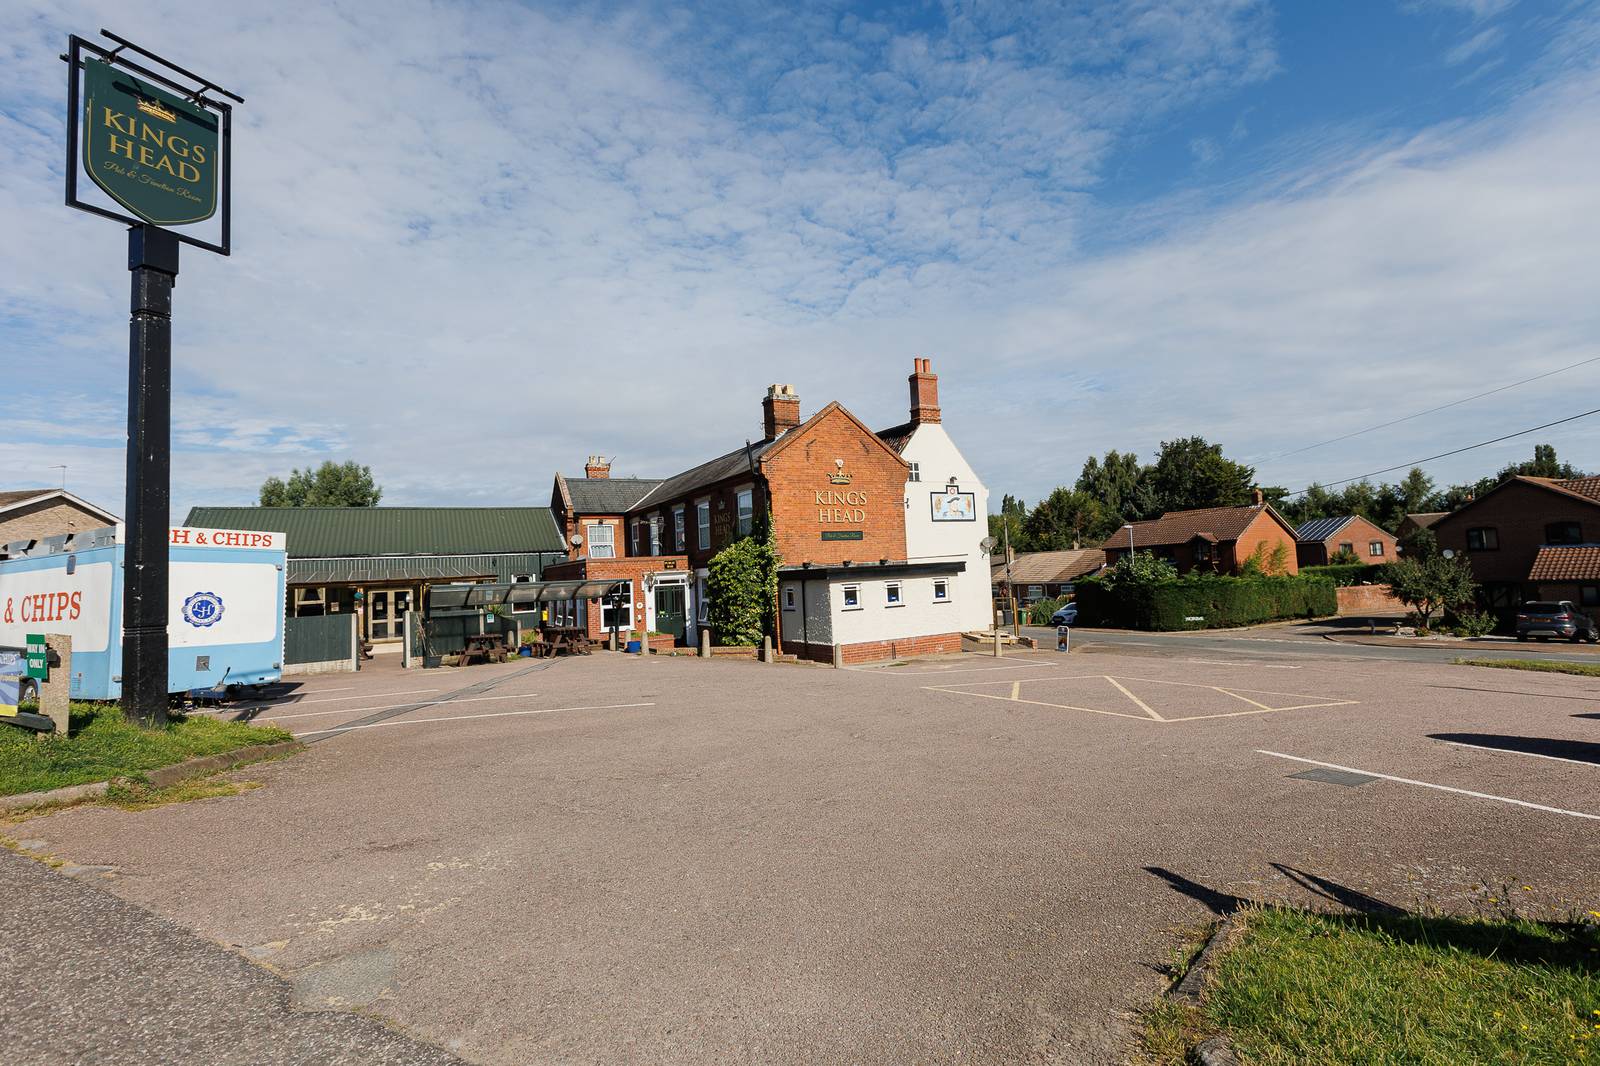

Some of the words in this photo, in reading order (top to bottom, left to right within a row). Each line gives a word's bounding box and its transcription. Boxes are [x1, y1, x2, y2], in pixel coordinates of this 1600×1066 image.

[103, 106, 206, 164] KINGS
[109, 133, 201, 183] HEAD
[814, 490, 867, 506] KINGS
[818, 508, 865, 523] HEAD
[195, 532, 208, 545] &
[212, 531, 273, 547] CHIPS
[4, 597, 14, 623] &
[21, 591, 82, 623] CHIPS
[29, 658, 44, 669] ONLY
